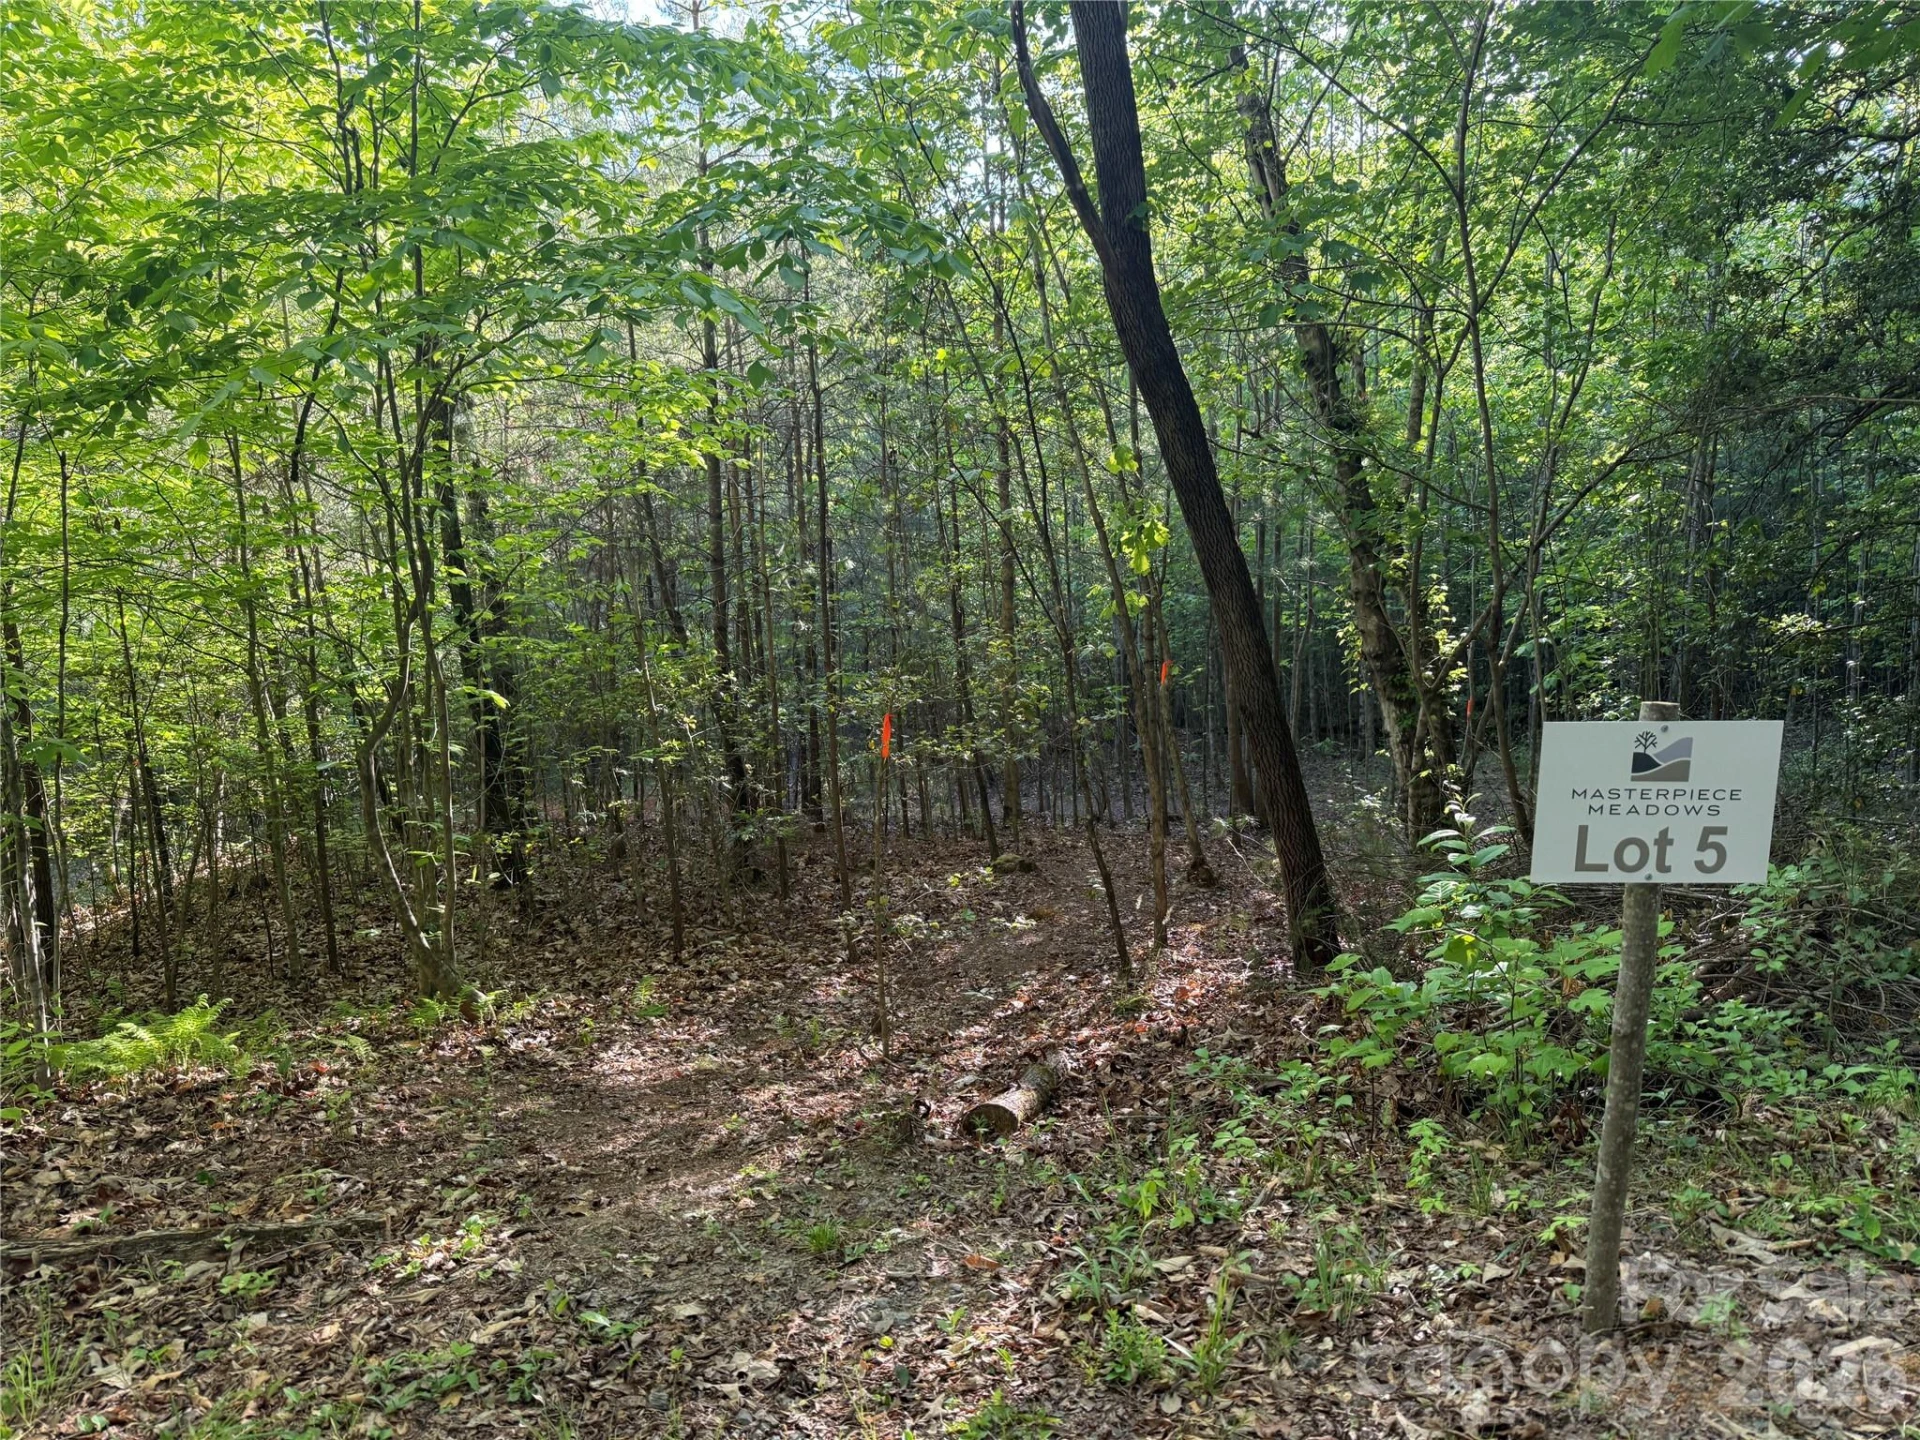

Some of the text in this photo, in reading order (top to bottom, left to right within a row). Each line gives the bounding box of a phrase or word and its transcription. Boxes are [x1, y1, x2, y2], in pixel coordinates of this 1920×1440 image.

[1571, 788, 1743, 801] MASTERPIECE
[1587, 804, 1721, 817] MEADOWS
[1574, 824, 1729, 875] Lot 5
